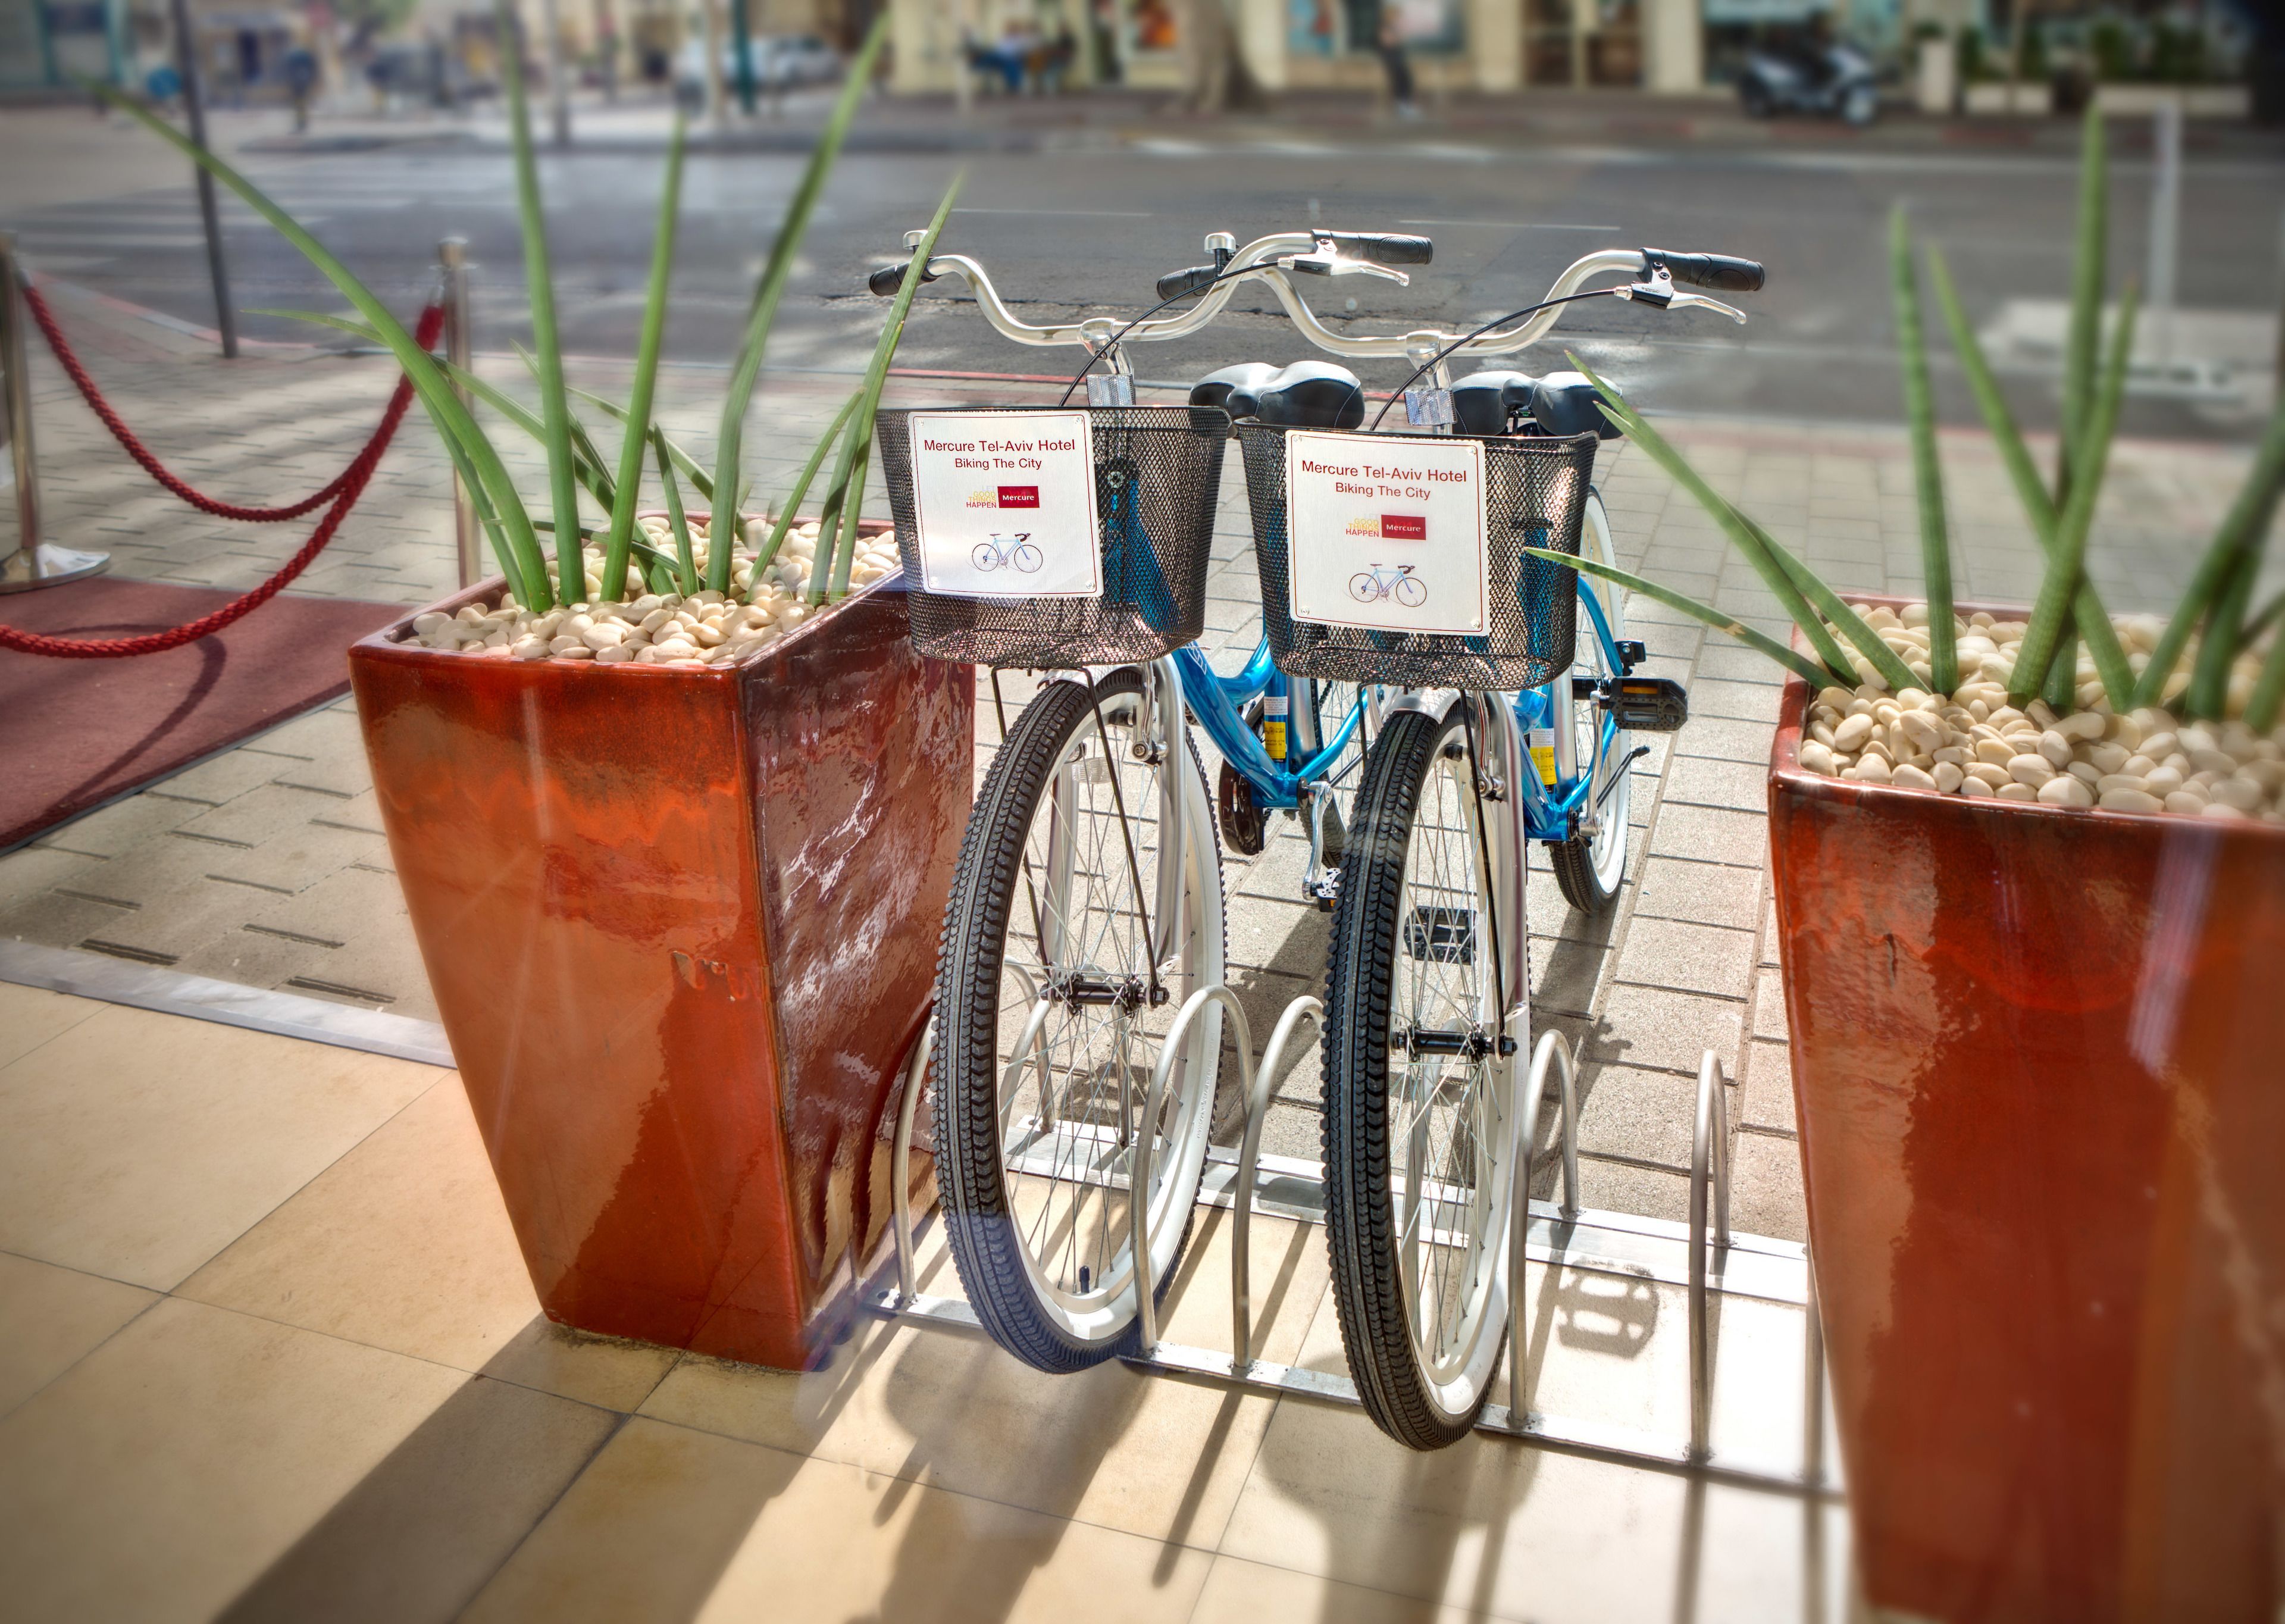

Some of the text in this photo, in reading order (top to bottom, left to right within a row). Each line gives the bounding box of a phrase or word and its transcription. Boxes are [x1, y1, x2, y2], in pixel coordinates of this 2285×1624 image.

[924, 439, 1075, 452] Mercure Tel-Aviv Hotel
[955, 458, 1042, 470] Biking The City
[1302, 460, 1467, 482] Mercure Tel-Aviv Hotel
[1336, 483, 1431, 500] Biking The City
[1345, 528, 1379, 537] HAPPEN
[1386, 524, 1421, 532] Mercure
